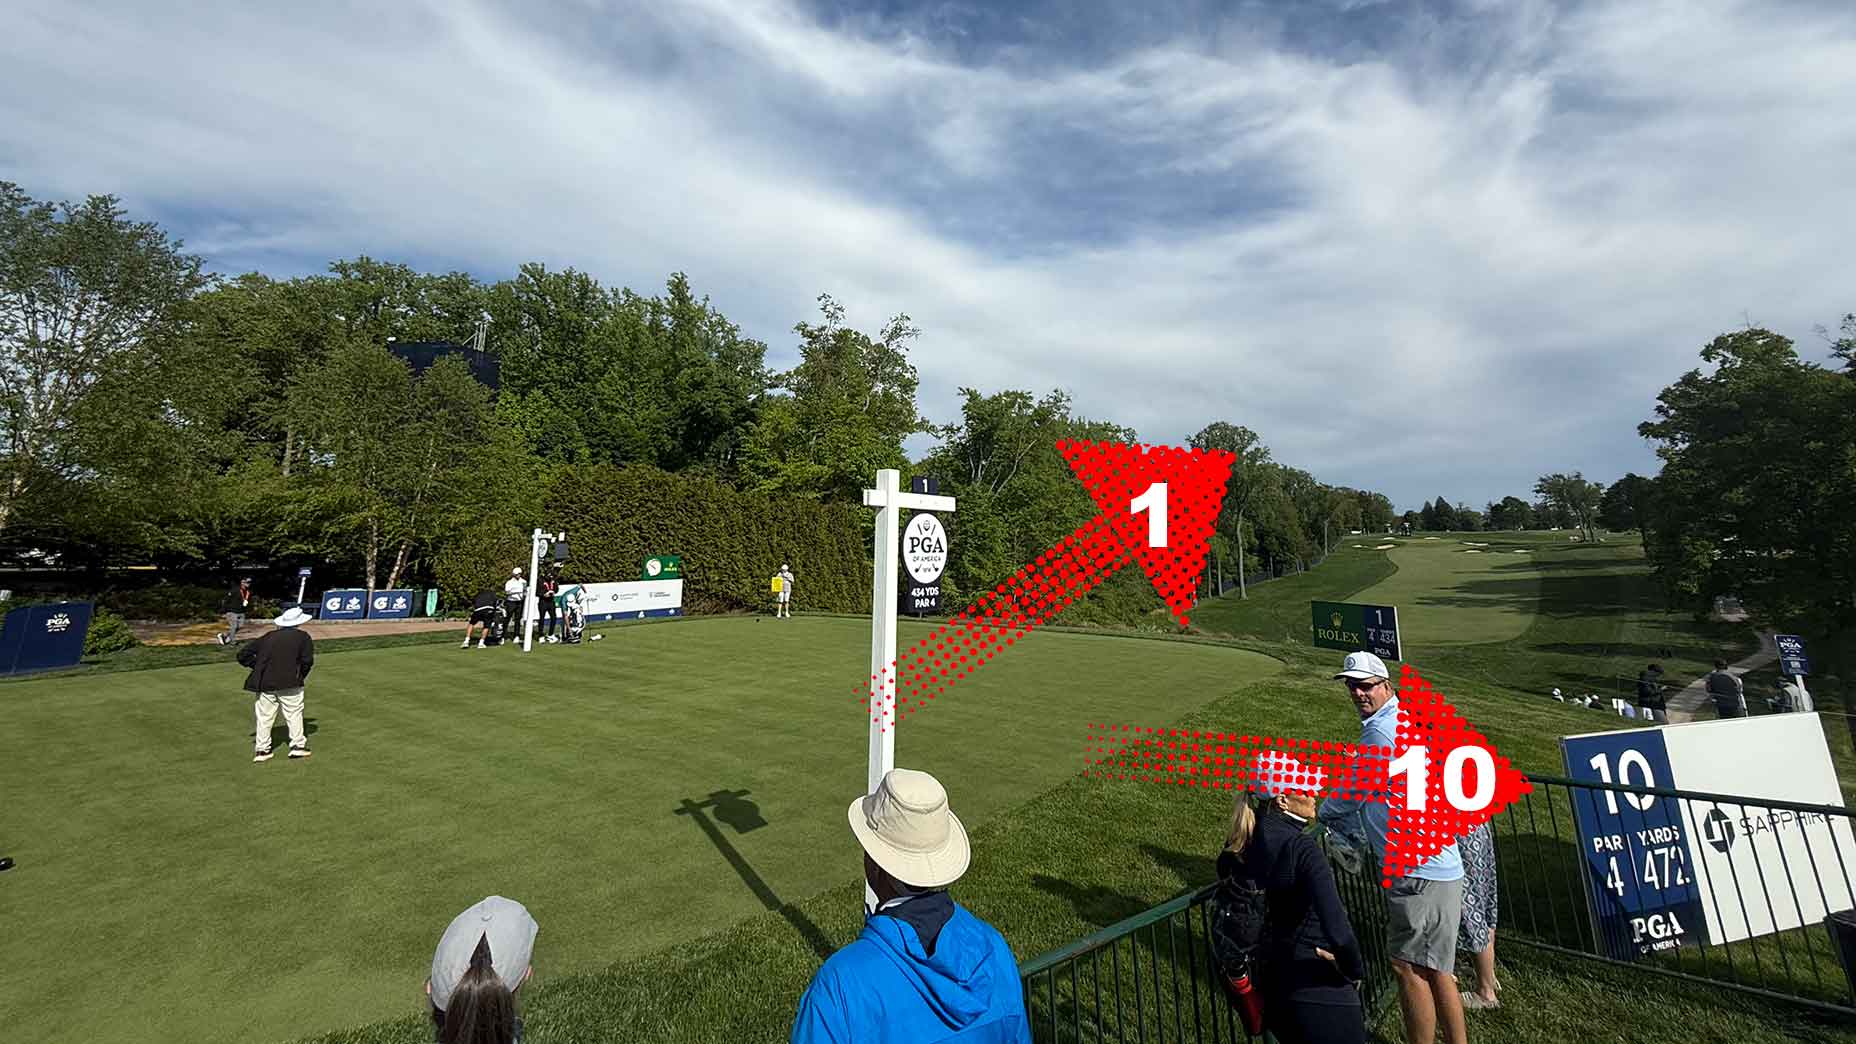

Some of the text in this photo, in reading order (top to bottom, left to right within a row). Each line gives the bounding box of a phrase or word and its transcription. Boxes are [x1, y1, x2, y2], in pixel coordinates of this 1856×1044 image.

[922, 478, 928, 493] 1
[909, 536, 944, 554] PGA
[911, 586, 939, 597] 434 YDS
[914, 597, 936, 608] PAR 4
[1375, 609, 1382, 625] 1
[1318, 628, 1360, 644] ROLEX
[1589, 748, 1656, 816] 10
[1593, 825, 1680, 853] PAR YARDS
[1606, 845, 1691, 897] 4 472
[1630, 911, 1685, 944] PGA
